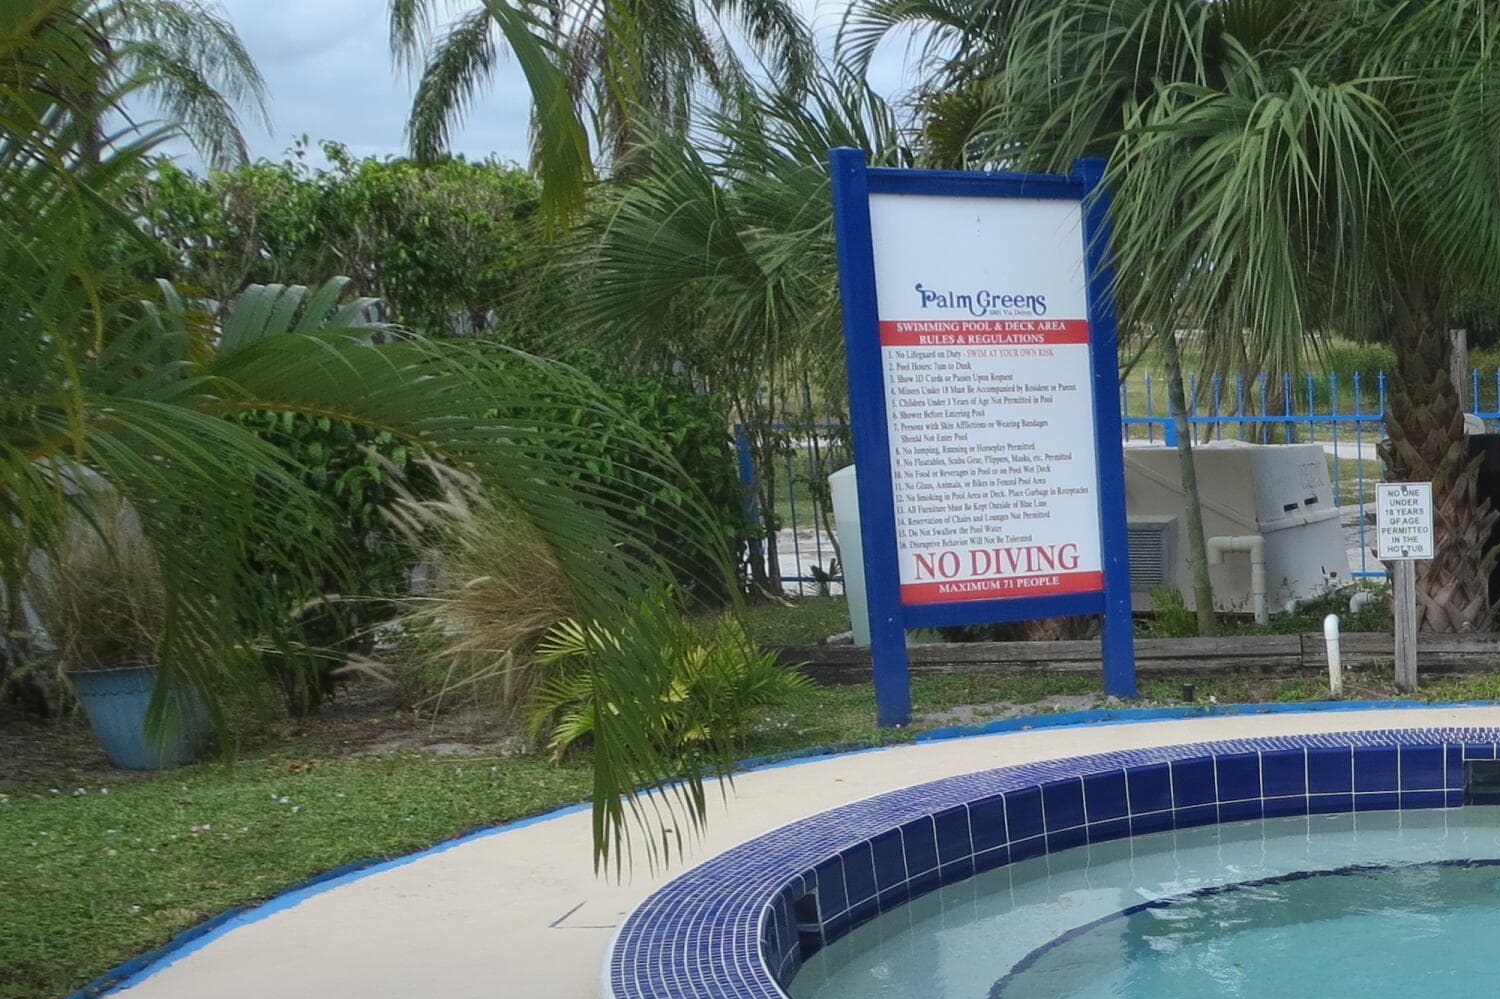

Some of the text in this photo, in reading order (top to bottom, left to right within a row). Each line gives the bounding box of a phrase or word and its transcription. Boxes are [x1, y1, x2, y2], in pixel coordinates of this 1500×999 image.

[915, 283, 1046, 316] Palm Greens
[896, 321, 1066, 332] SWIMMING POOL & DECK AREA
[919, 334, 1045, 345] RULES & REGULATIONS
[967, 349, 987, 358] SWIM
[999, 349, 1019, 357] YOUR
[1020, 349, 1037, 357] OWN
[1039, 349, 1054, 357] RISK
[1402, 489, 1420, 497] ONE
[1402, 517, 1420, 525] AGE
[1381, 526, 1429, 534] PERMITTED
[912, 543, 1080, 580] NO DIVING
[939, 576, 1060, 593] MAXIMUM 71 PEOPLE
